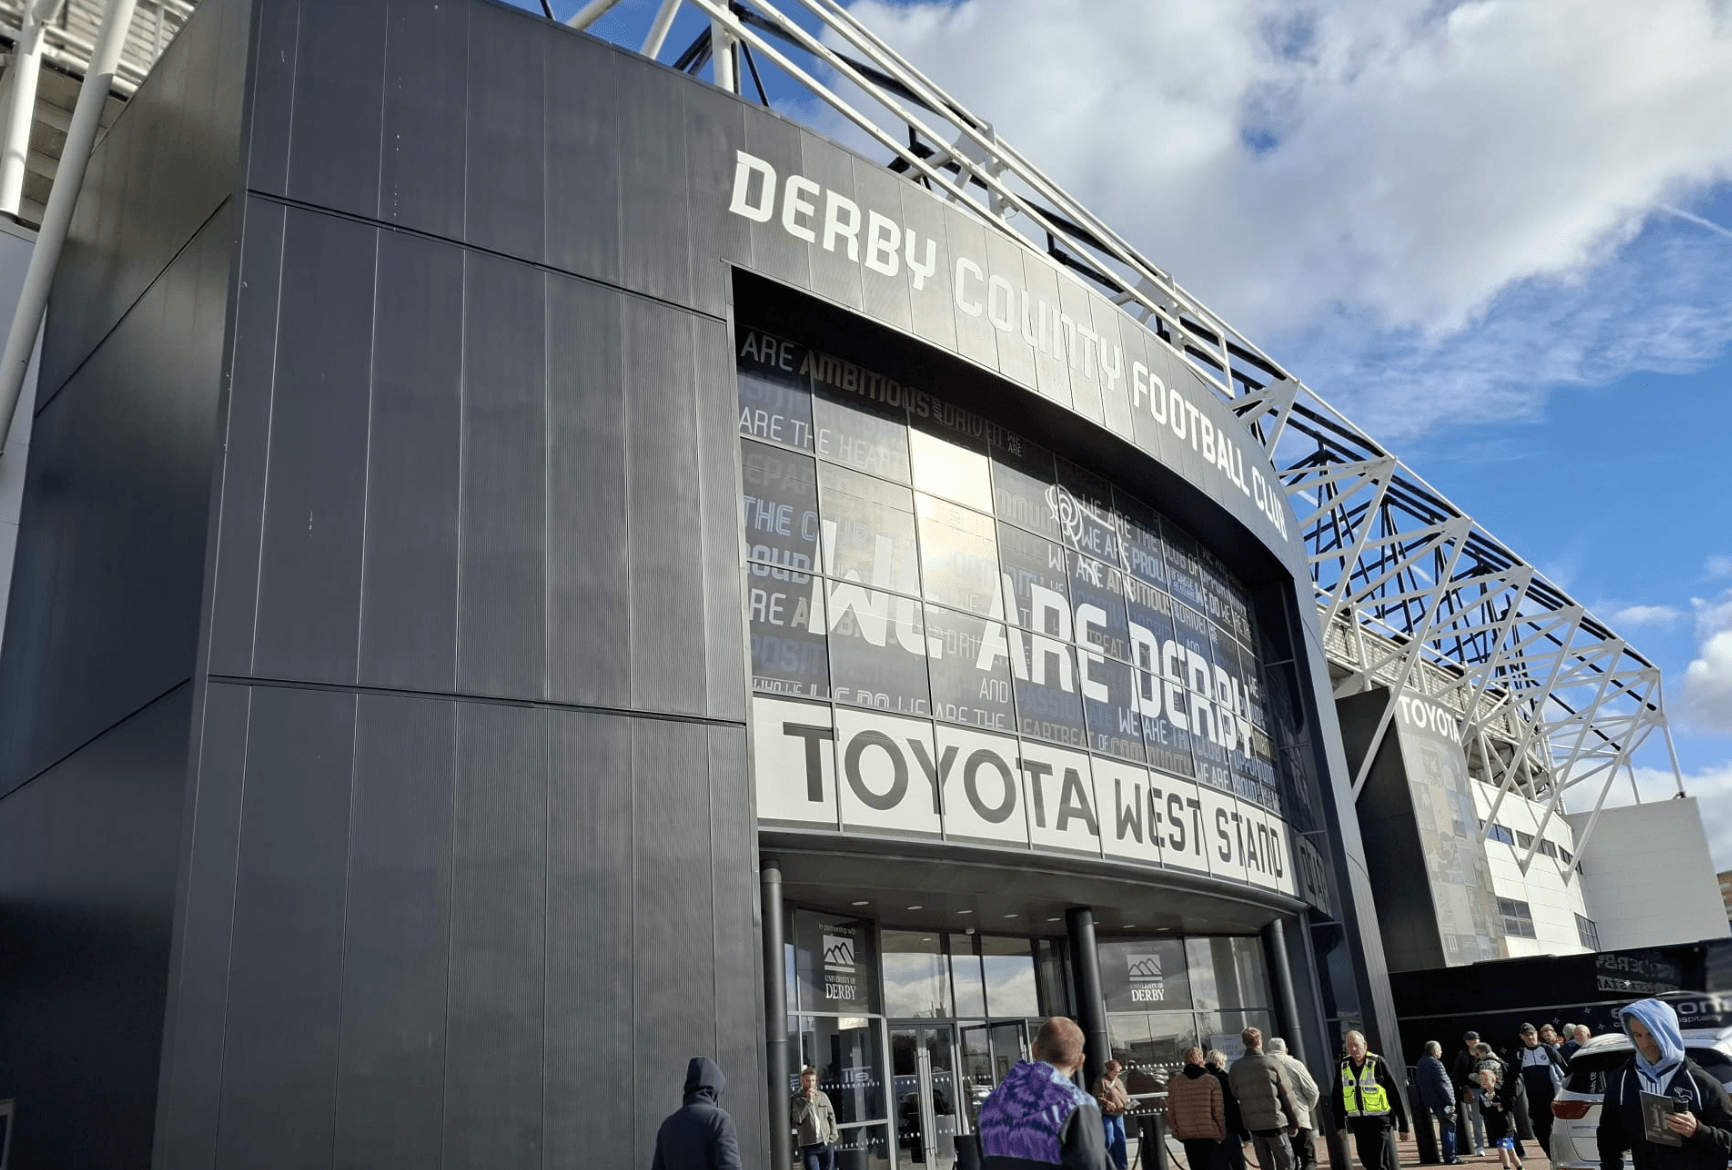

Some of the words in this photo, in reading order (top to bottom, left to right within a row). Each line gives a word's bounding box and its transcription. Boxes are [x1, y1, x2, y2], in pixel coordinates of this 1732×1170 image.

[729, 150, 937, 292] DERBY
[954, 257, 1122, 391] COUNTY
[1132, 361, 1251, 499] FOOTBALL
[1252, 465, 1288, 542] CLUB
[741, 331, 795, 372] ARE
[799, 351, 931, 418] AMBITIOUS
[740, 406, 783, 441] ARE
[790, 418, 831, 455] THE
[744, 495, 793, 538] THE
[745, 542, 812, 585] OUD
[750, 588, 786, 626] RE
[808, 519, 943, 660] WE
[976, 570, 1109, 703] ARE
[1130, 620, 1252, 760] DERBY
[979, 677, 1009, 704] AND
[1118, 706, 1140, 737] WE
[1143, 716, 1168, 745] ARE
[1398, 695, 1462, 747] TOYOTA
[1098, 734, 1109, 752] OF
[782, 721, 1099, 837] TOYOTA
[1114, 778, 1202, 857] WEST
[1215, 807, 1283, 879] STAND
[826, 984, 856, 1000] DERBY
[1131, 989, 1165, 1002] DERBY
